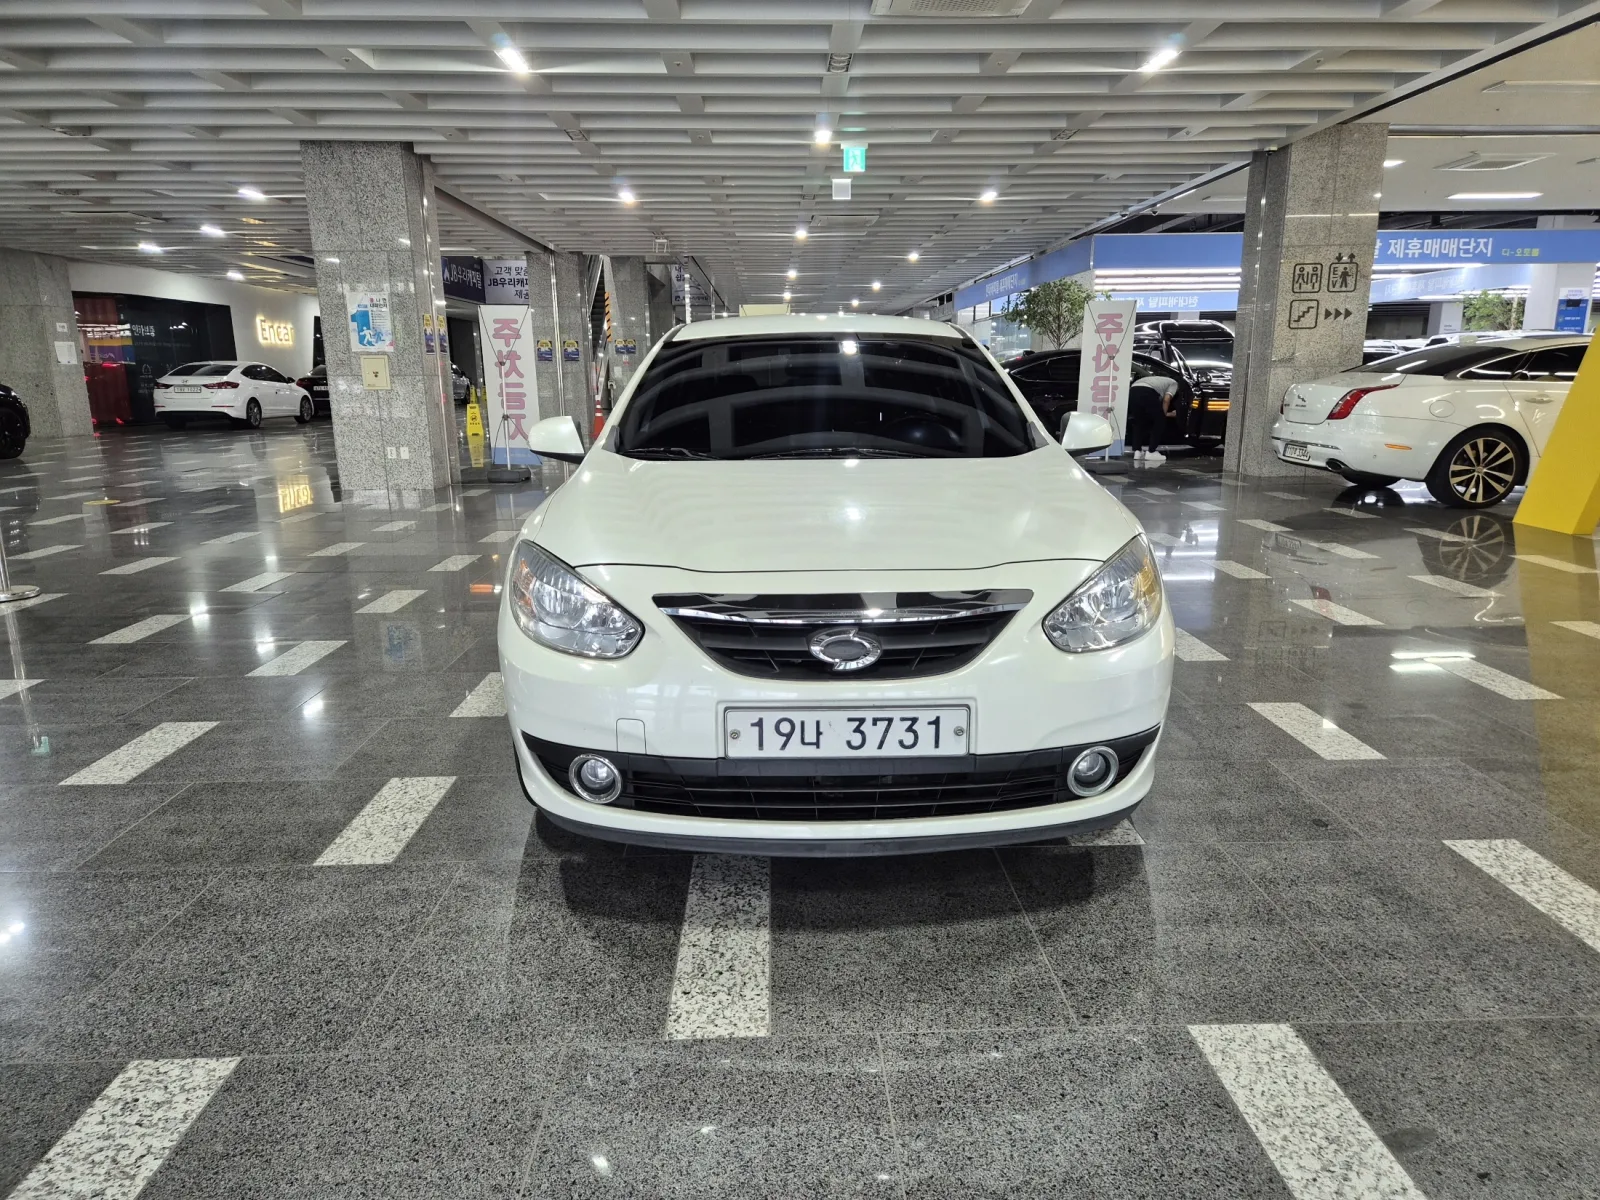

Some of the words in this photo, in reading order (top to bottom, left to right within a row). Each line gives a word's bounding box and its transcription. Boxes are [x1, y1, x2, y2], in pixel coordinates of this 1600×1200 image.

[1387, 237, 1493, 259] 제휴매매단지
[450, 263, 483, 290] JB우리캐피탈
[494, 266, 512, 276] 고객
[258, 316, 295, 345] Encar
[750, 717, 824, 751] 19나
[845, 716, 942, 751] 3731
